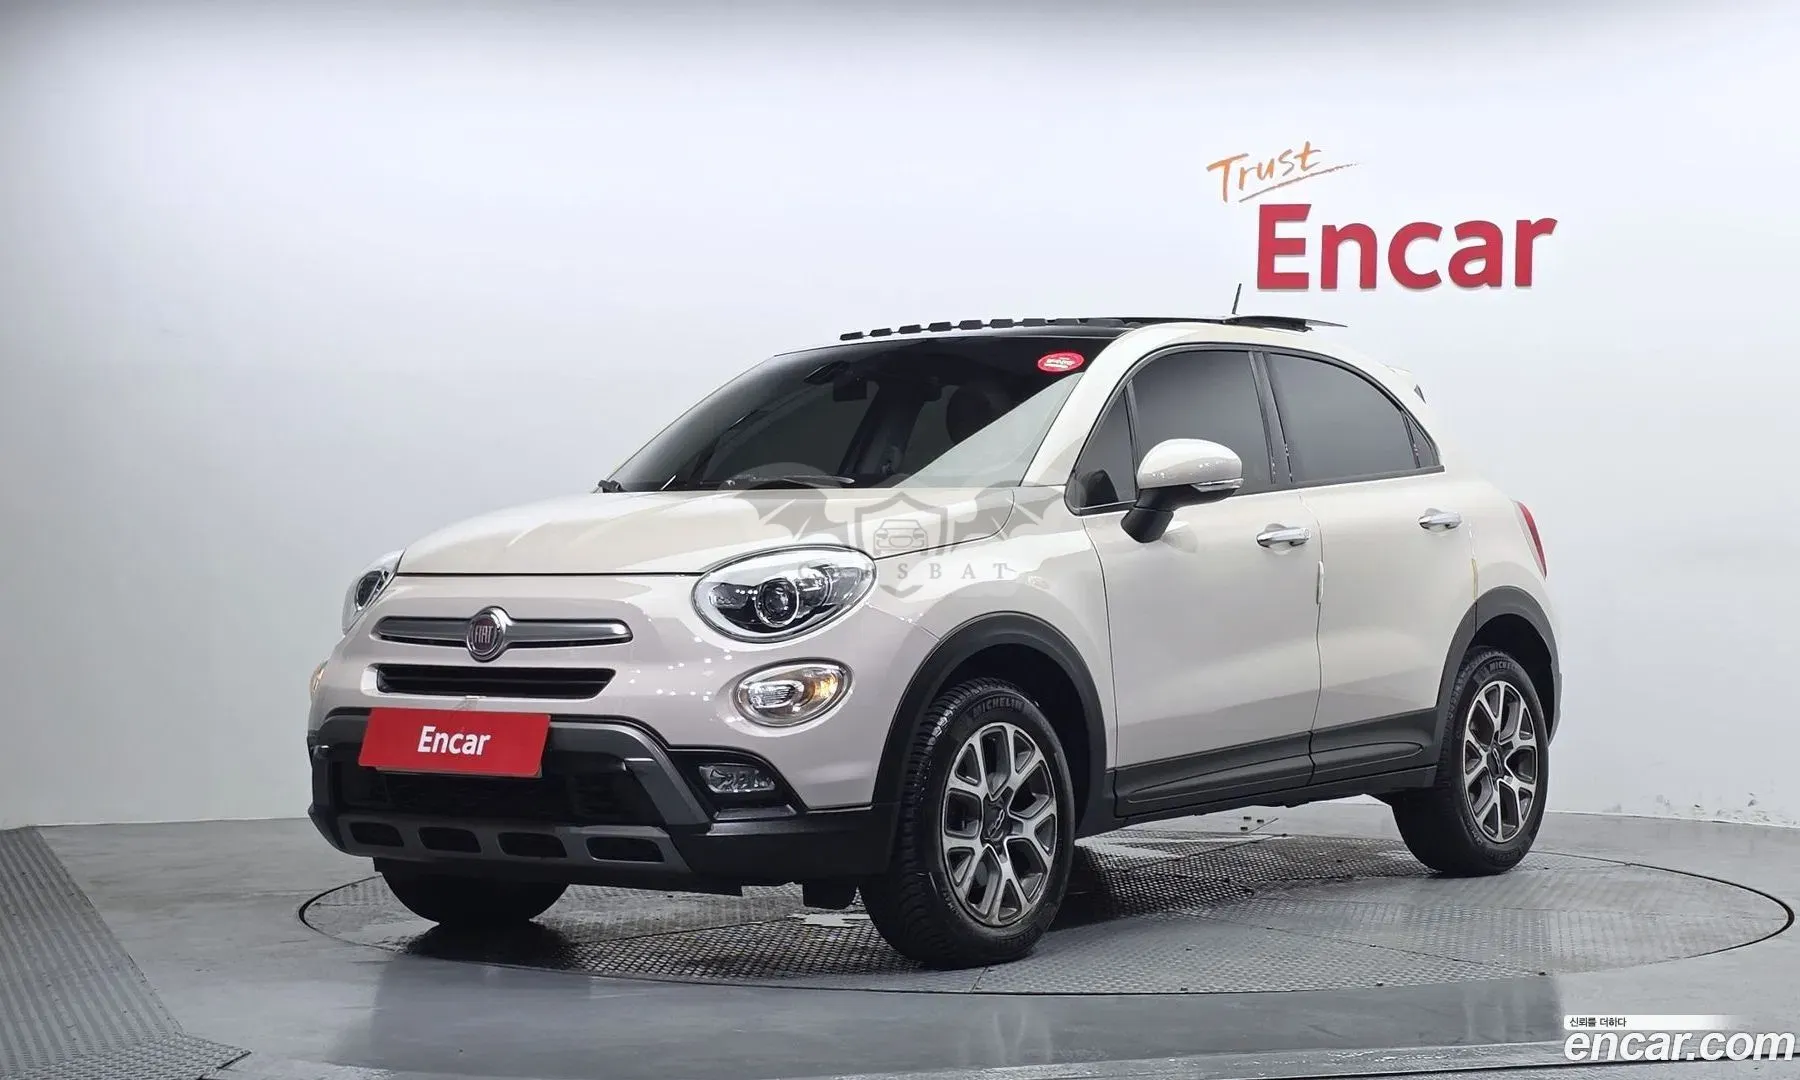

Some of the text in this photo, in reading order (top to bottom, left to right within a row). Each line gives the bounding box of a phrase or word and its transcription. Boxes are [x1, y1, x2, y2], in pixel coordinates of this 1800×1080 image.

[1206, 141, 1322, 203] Trust
[1256, 203, 1558, 290] Encar
[474, 625, 494, 644] FIAT
[973, 696, 1024, 718] MICHELIN
[417, 725, 491, 756] Encar
